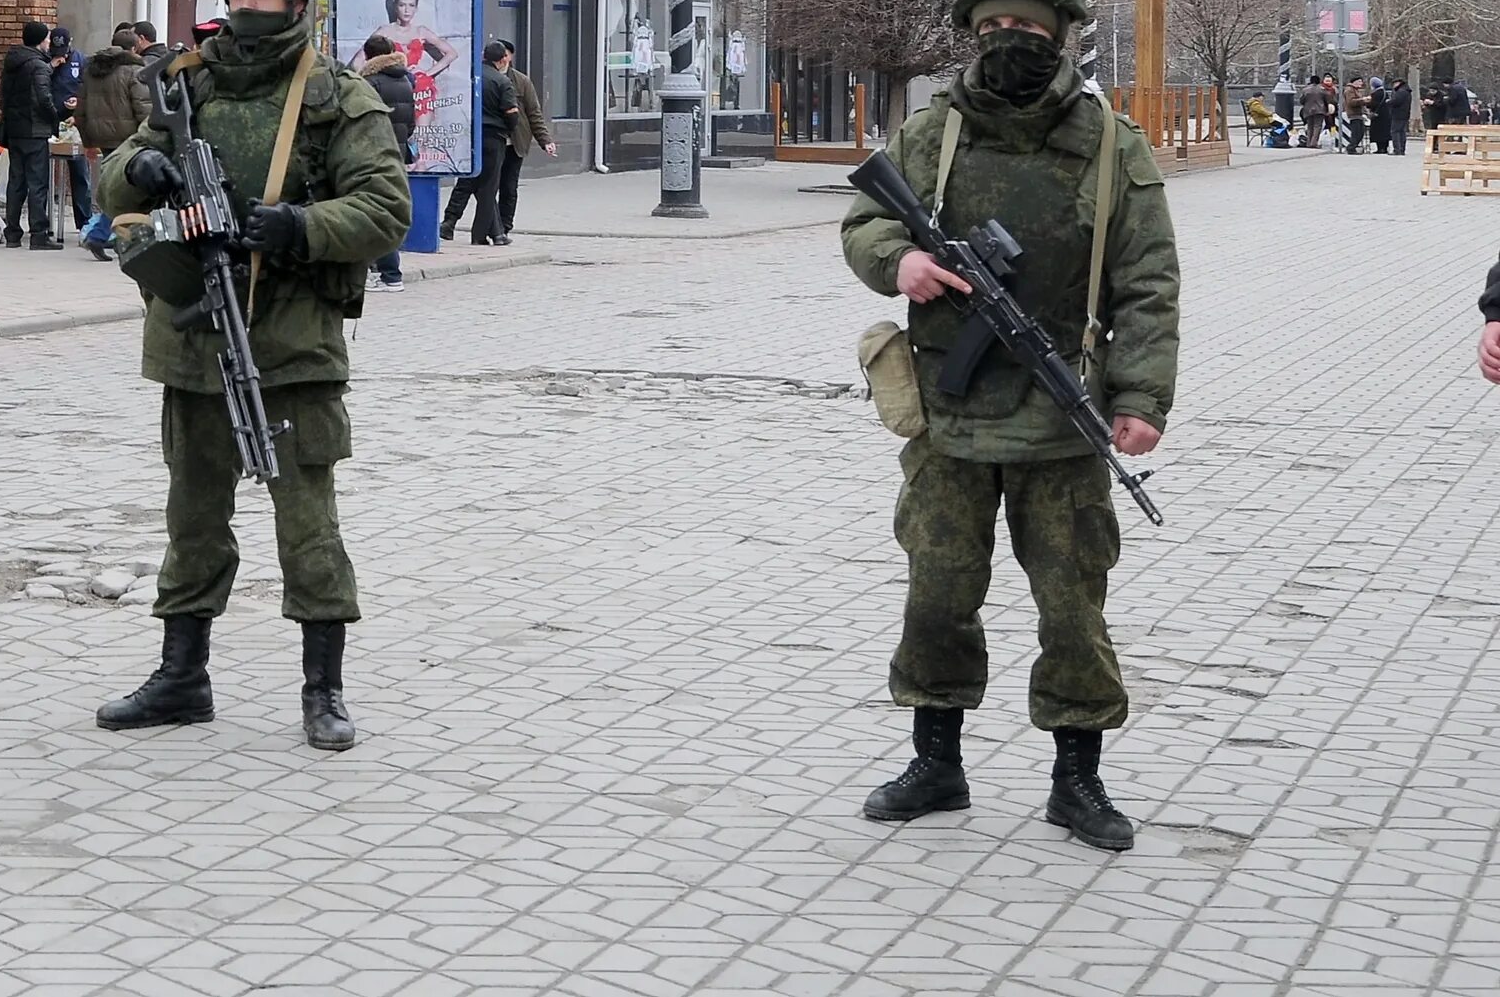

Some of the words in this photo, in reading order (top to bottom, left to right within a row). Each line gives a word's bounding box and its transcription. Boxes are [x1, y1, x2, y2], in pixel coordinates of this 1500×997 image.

[426, 93, 464, 110] ценам!
[412, 124, 447, 136] аркса,
[416, 137, 457, 149] 7-21-19
